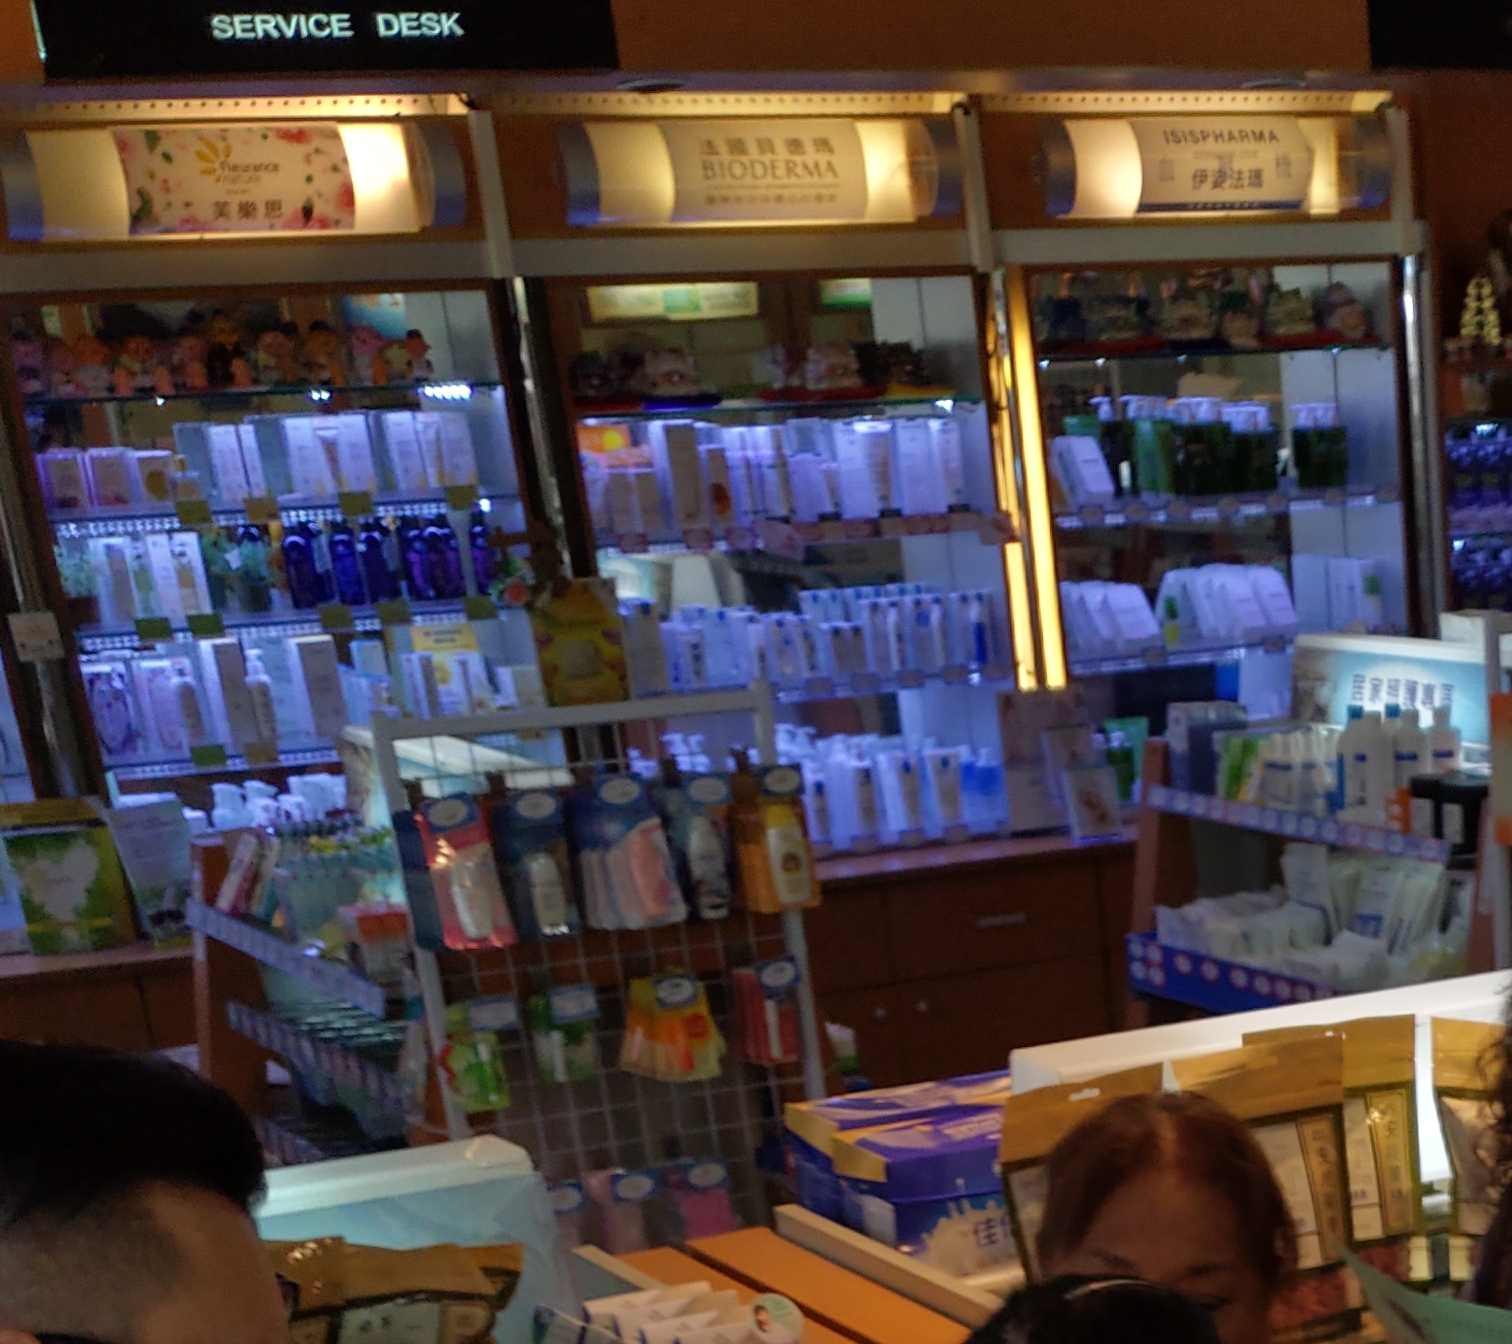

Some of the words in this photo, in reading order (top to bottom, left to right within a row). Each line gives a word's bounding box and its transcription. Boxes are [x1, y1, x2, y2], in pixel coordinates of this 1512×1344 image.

[211, 13, 354, 40] SERVICE
[376, 12, 465, 38] DESK
[1162, 129, 1280, 145] ISISPHARMA
[701, 158, 839, 181] BIODERMA
